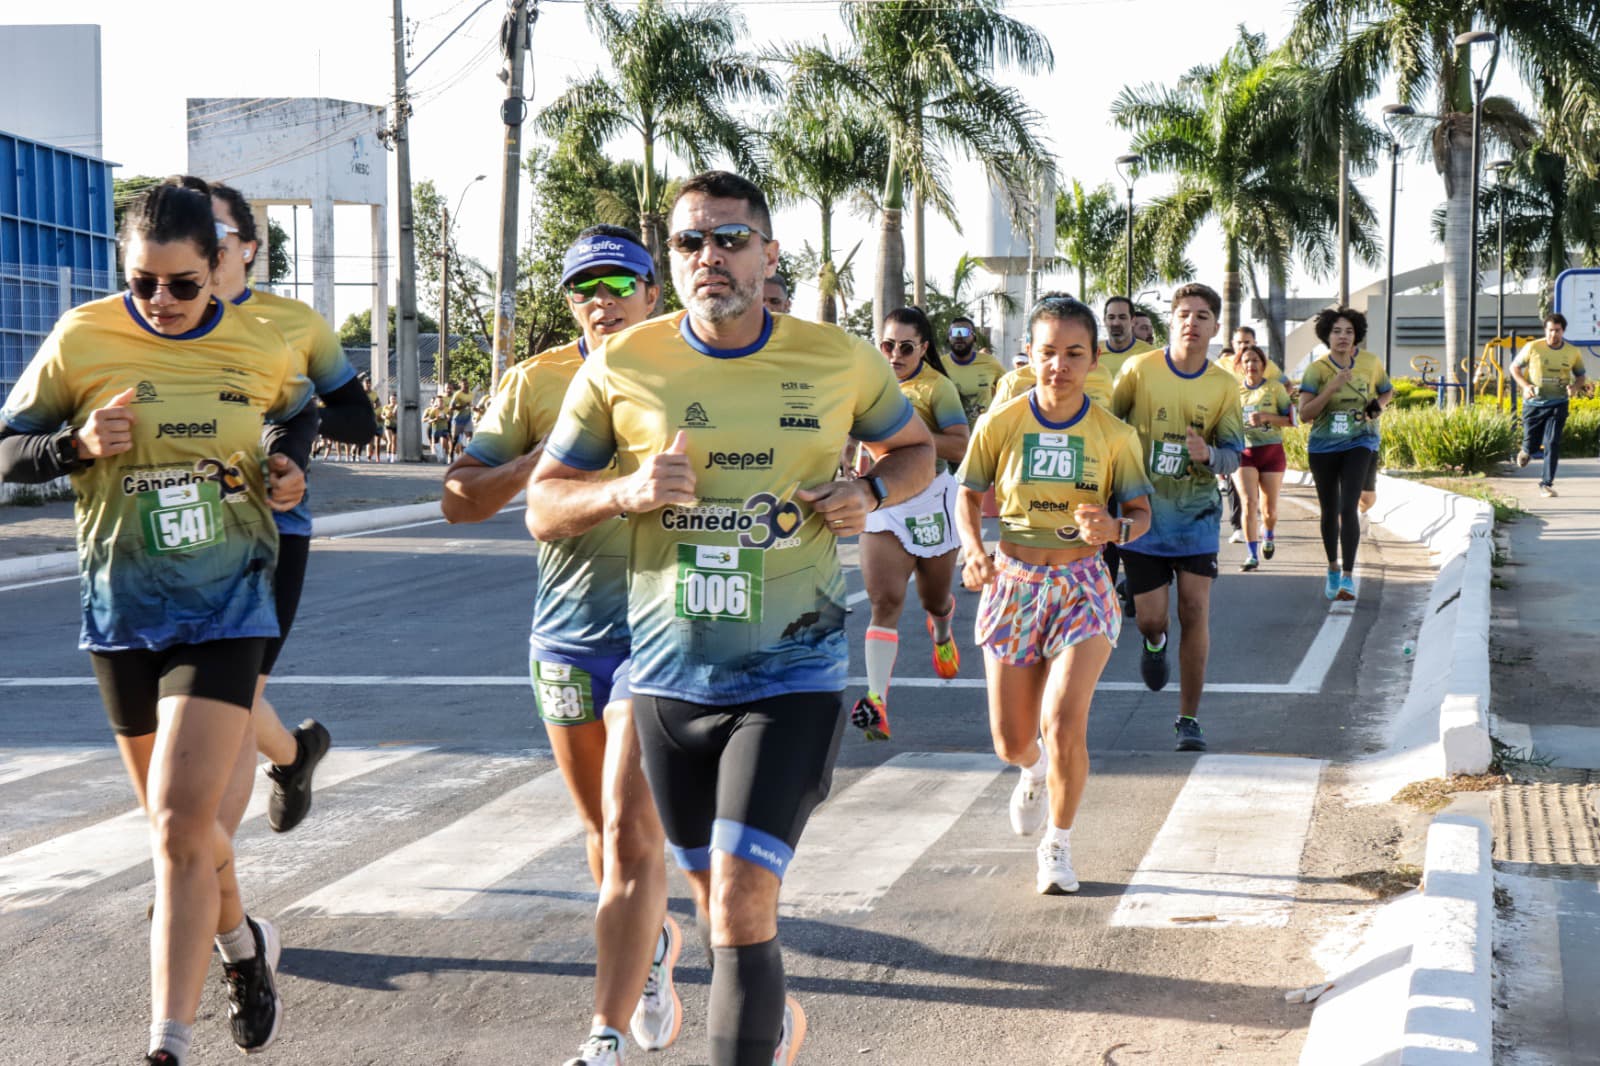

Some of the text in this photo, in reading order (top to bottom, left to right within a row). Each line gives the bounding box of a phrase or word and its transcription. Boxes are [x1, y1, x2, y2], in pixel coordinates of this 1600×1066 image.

[1033, 450, 1072, 477] 276
[1157, 455, 1182, 473] 207
[159, 506, 208, 547] 541
[661, 509, 753, 531] Canedo
[687, 573, 746, 615] 006
